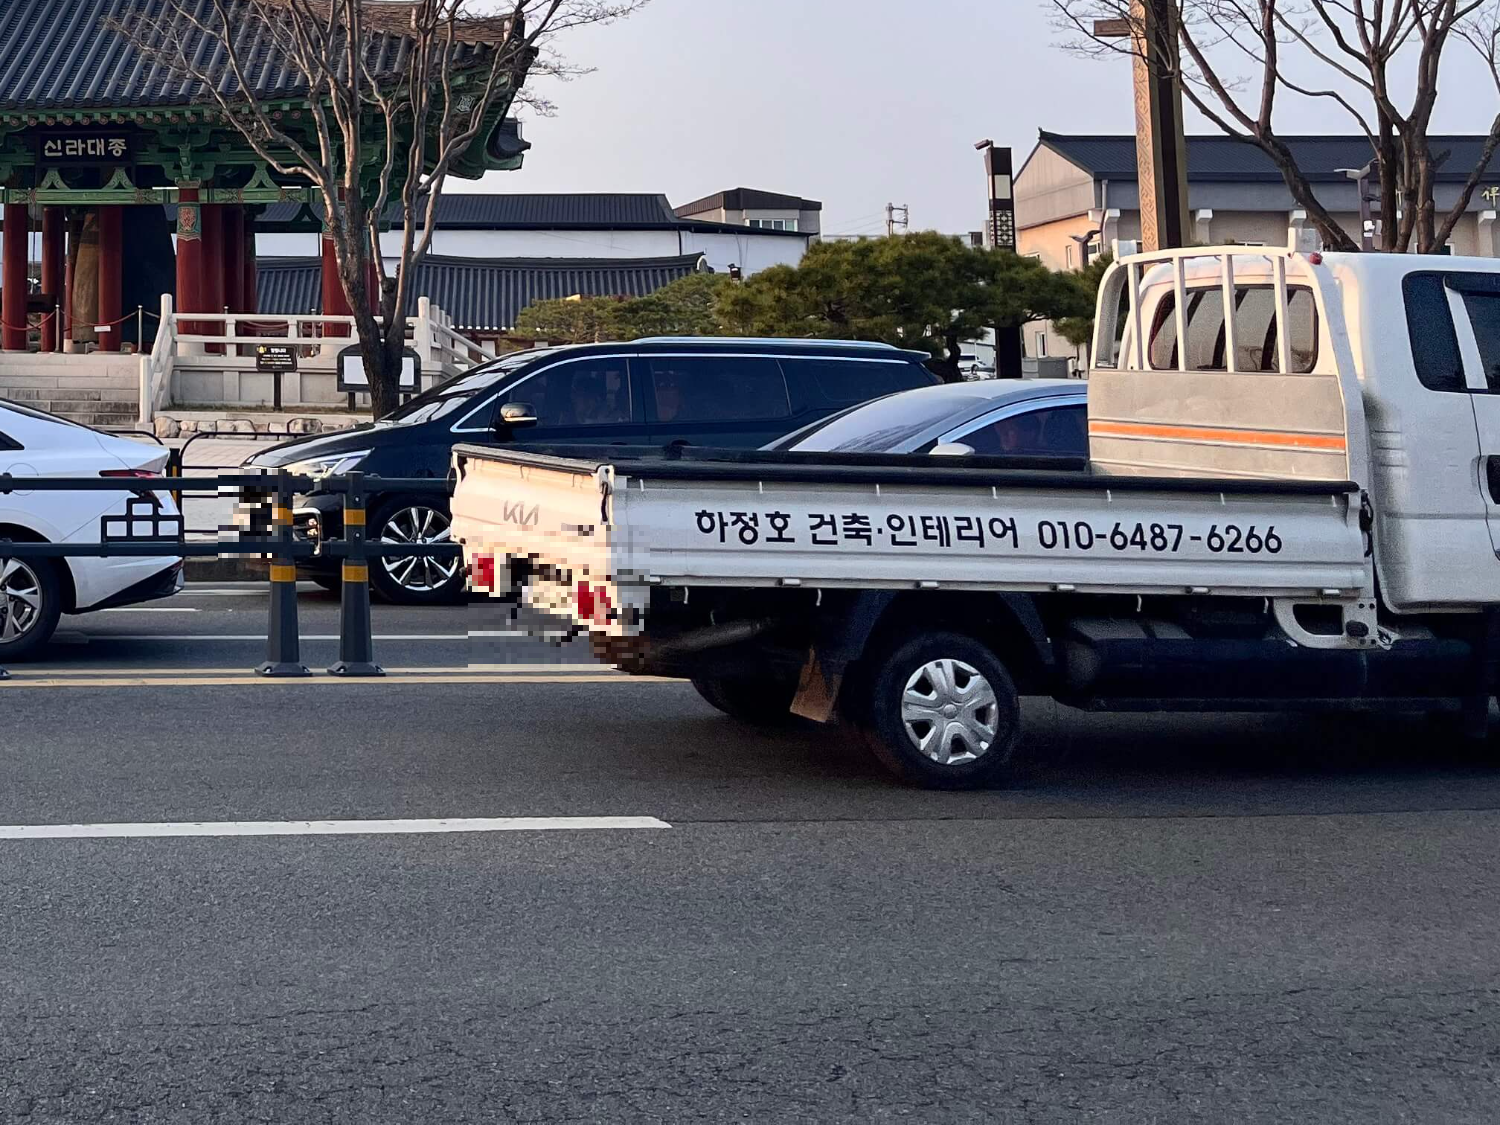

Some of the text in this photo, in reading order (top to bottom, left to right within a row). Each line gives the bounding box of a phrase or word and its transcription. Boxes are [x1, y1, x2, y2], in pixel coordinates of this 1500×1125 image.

[44, 138, 127, 156] 신라대종
[503, 500, 540, 525] KIA
[695, 510, 795, 545] 하정호
[1038, 520, 1282, 554] 010-6487-6266
